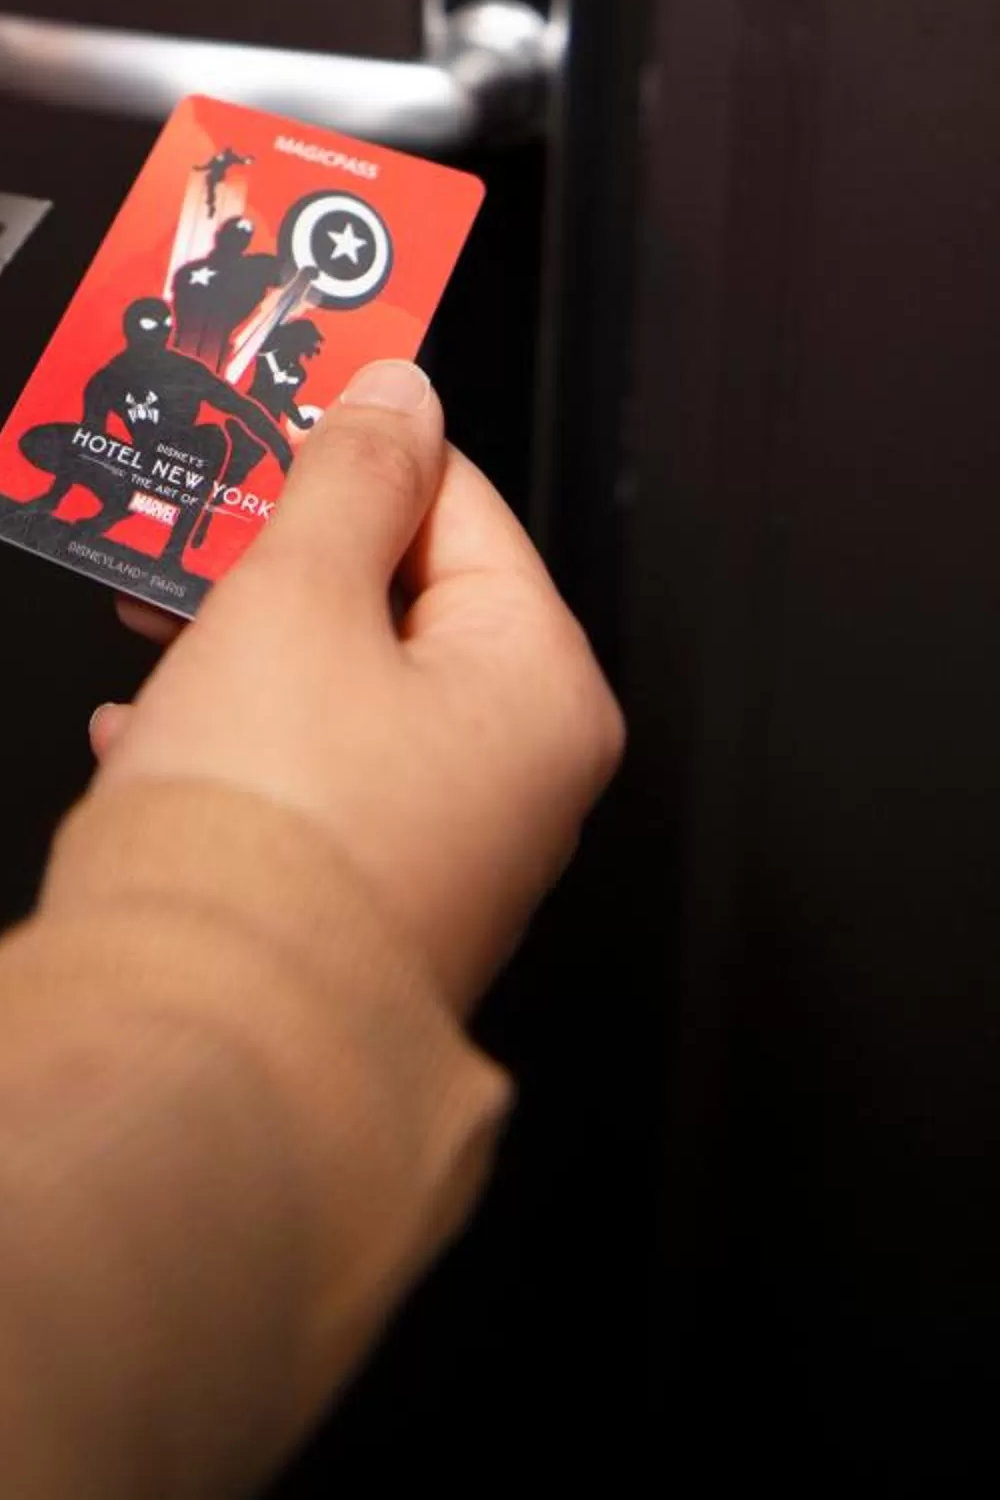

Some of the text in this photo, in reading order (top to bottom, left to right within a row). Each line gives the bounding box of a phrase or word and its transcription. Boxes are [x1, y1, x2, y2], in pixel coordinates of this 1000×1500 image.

[274, 135, 379, 181] MAGICPASS
[71, 427, 275, 519] HOTEL NEW YORK
[130, 473, 199, 506] THE ART OF
[127, 491, 181, 527] MARVEL
[150, 575, 187, 598] PARIS
